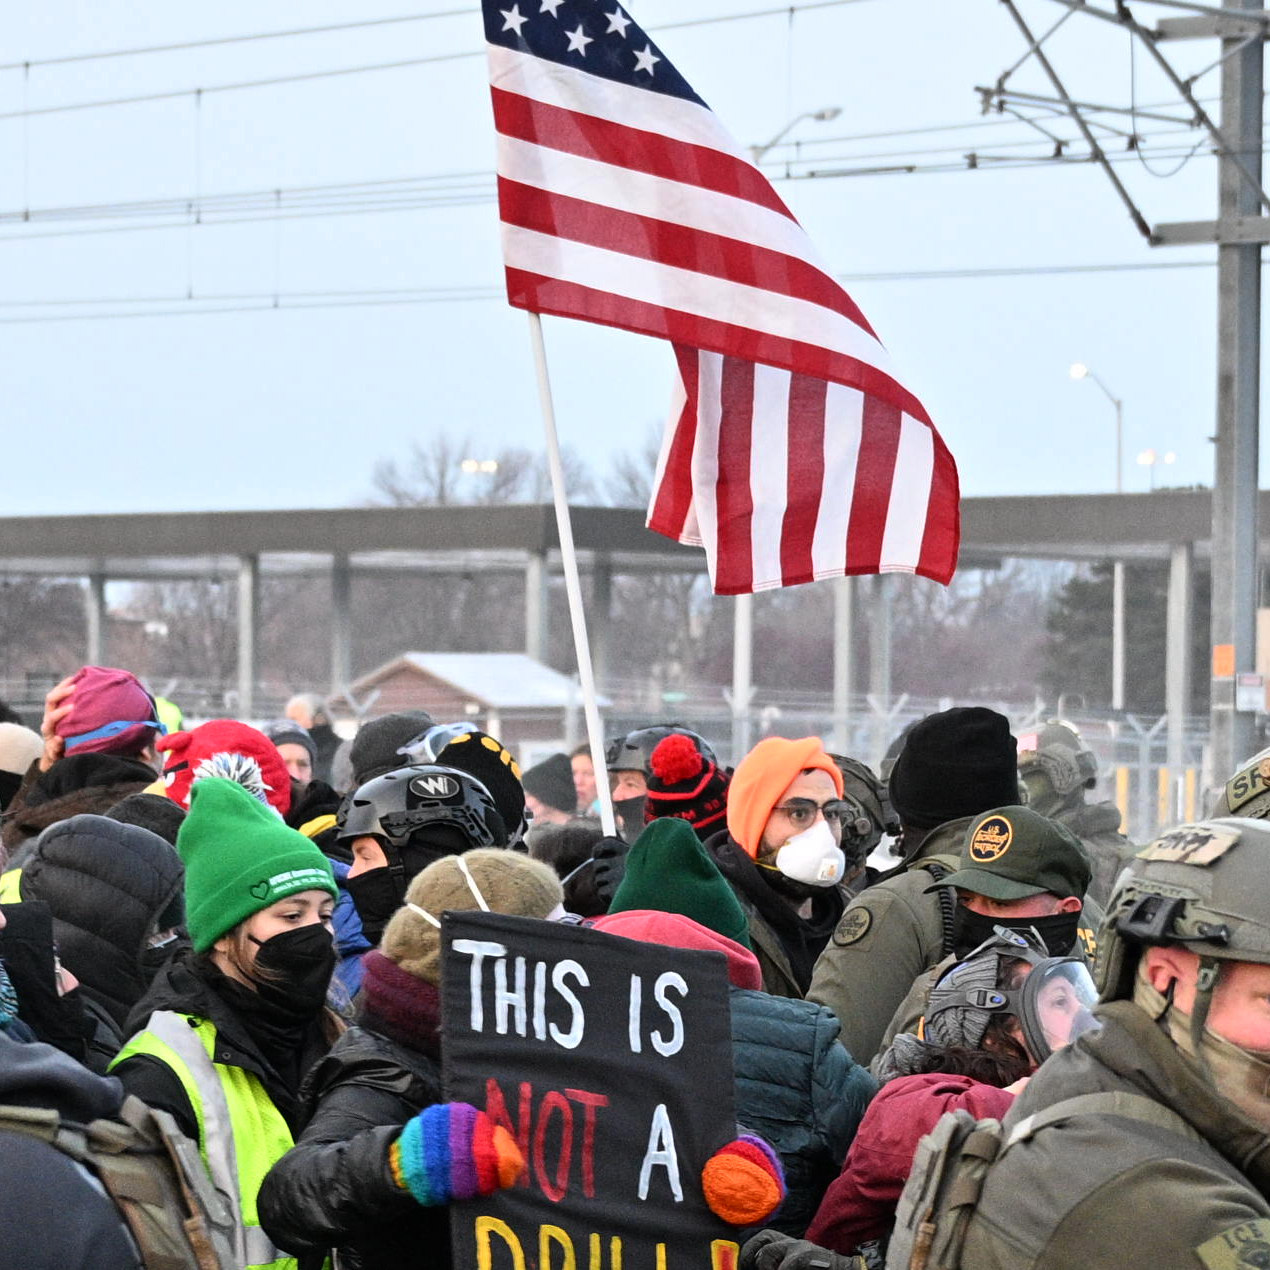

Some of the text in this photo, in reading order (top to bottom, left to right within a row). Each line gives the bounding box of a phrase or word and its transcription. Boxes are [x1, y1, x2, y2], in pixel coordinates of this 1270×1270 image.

[452, 939, 689, 1057] THIS IS
[485, 1077, 684, 1202] NOT A
